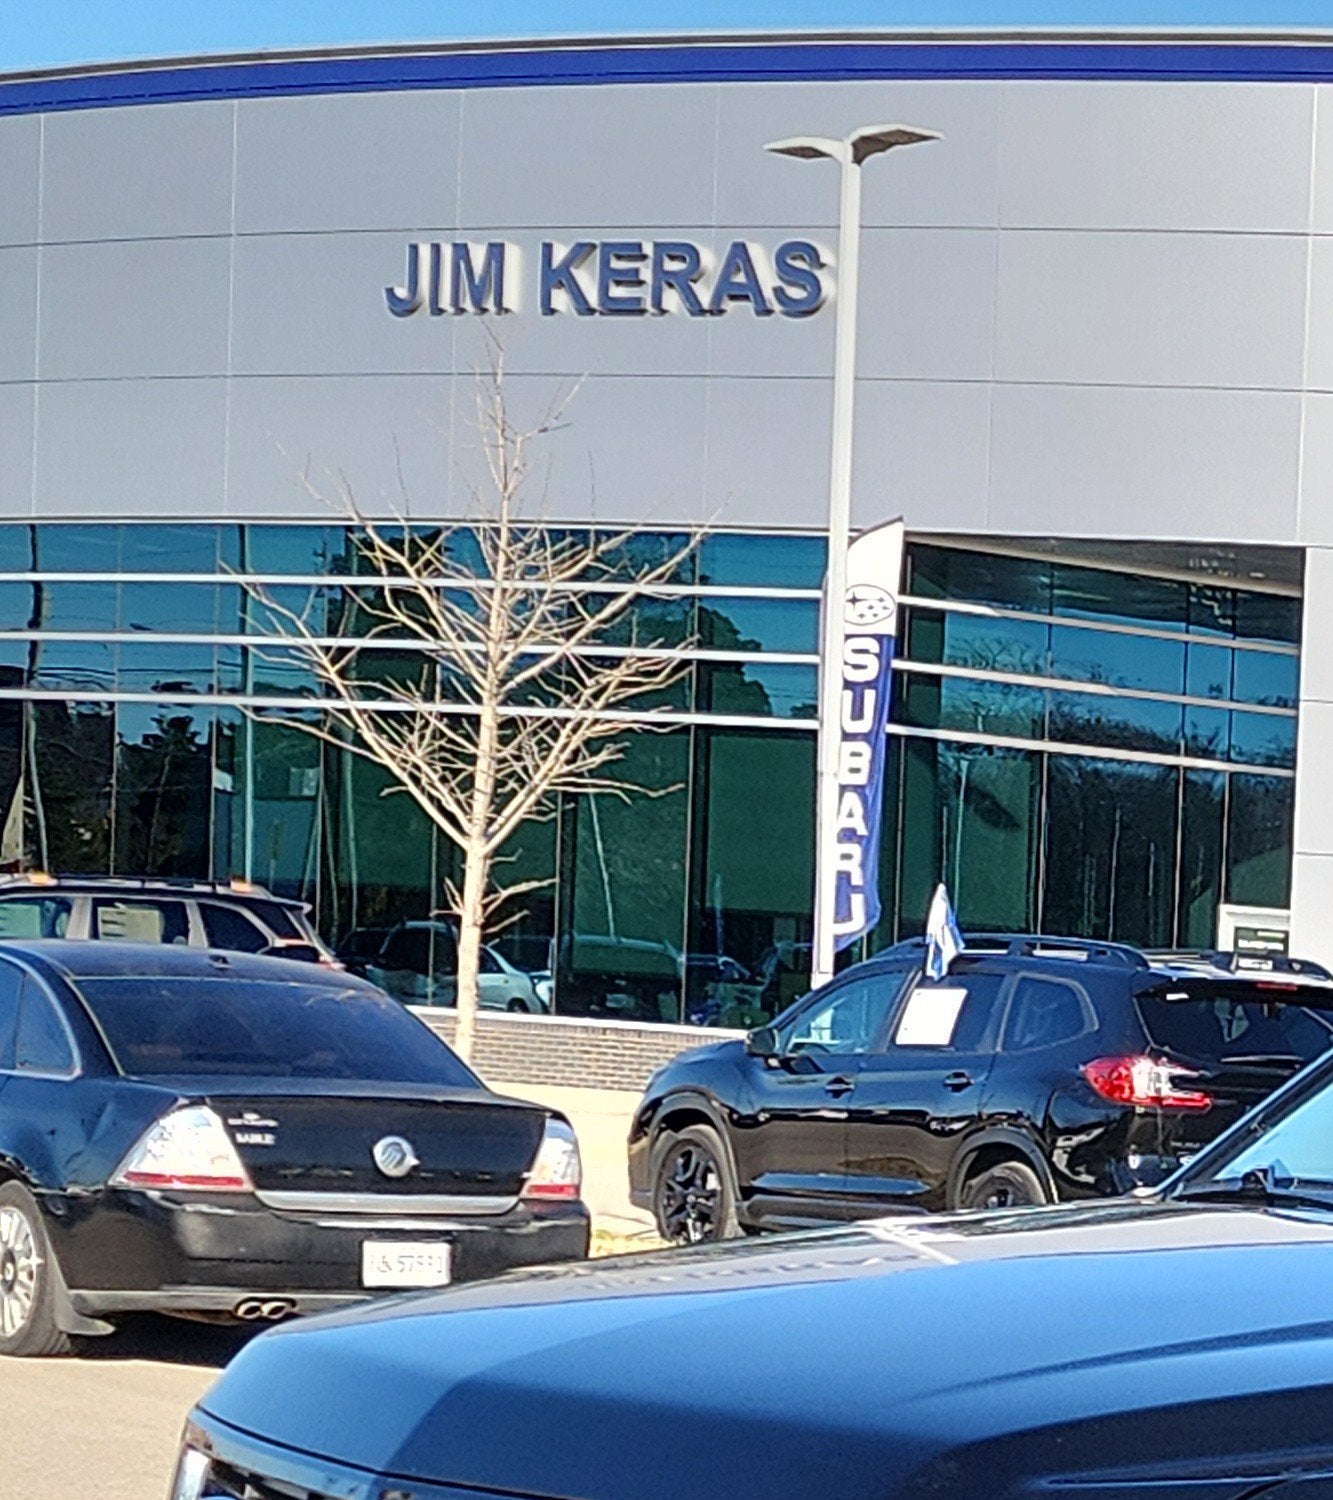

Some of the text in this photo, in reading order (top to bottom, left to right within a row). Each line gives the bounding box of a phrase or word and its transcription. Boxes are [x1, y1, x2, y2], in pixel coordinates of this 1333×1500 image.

[384, 240, 827, 318] JIM KERAS
[832, 636, 881, 935] SUBARU
